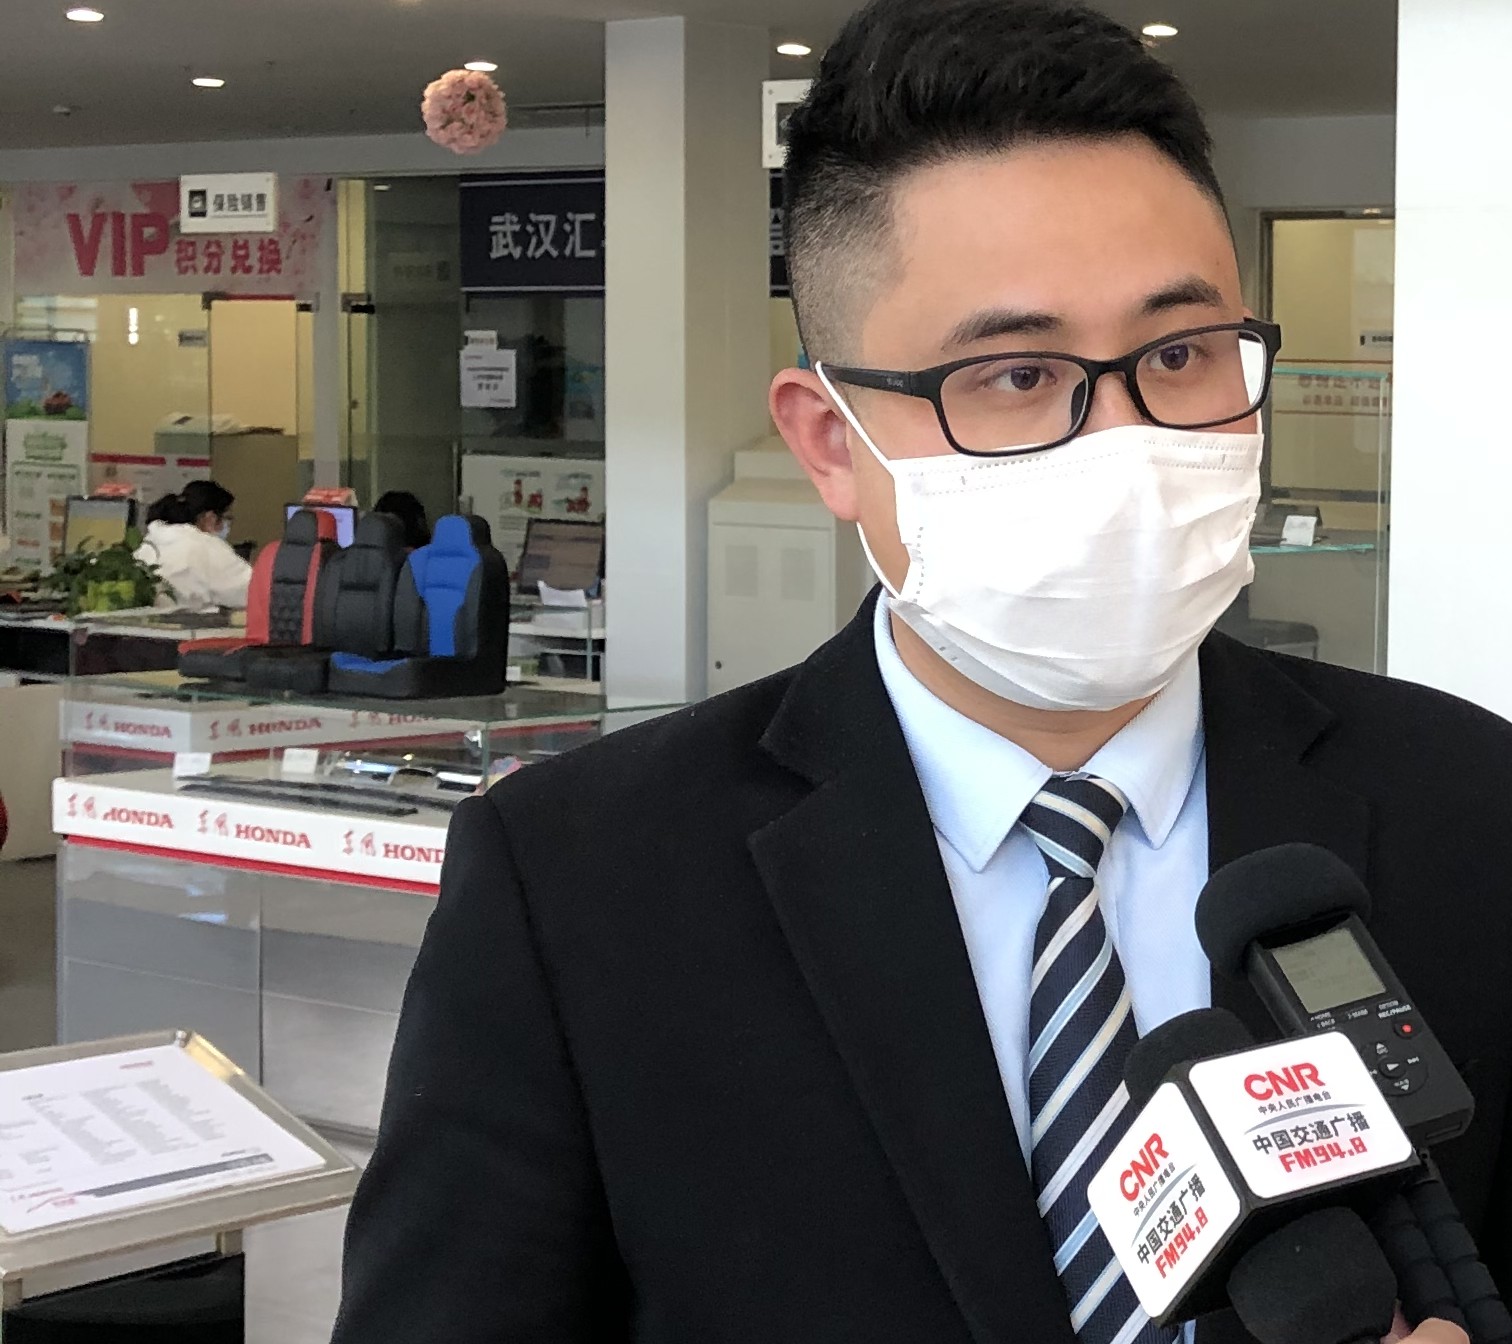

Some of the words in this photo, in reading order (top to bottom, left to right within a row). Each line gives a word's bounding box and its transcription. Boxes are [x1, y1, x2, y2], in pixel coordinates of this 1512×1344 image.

[66, 211, 170, 277] VIP
[174, 238, 283, 276] 积分兑换
[488, 212, 604, 260] 武汉汇
[102, 806, 174, 829] HONDA
[235, 823, 313, 849] HONDA
[382, 842, 444, 865] HOND
[1244, 1062, 1326, 1101] CNR
[1258, 1090, 1331, 1115] 中央人民广播电台
[1252, 1111, 1370, 1154] 中国交通广播
[1120, 1132, 1169, 1201] CNR
[1278, 1136, 1368, 1173] FM94.8
[1137, 1173, 1206, 1264] 中国交通广播
[1155, 1206, 1208, 1279] FM94.8
